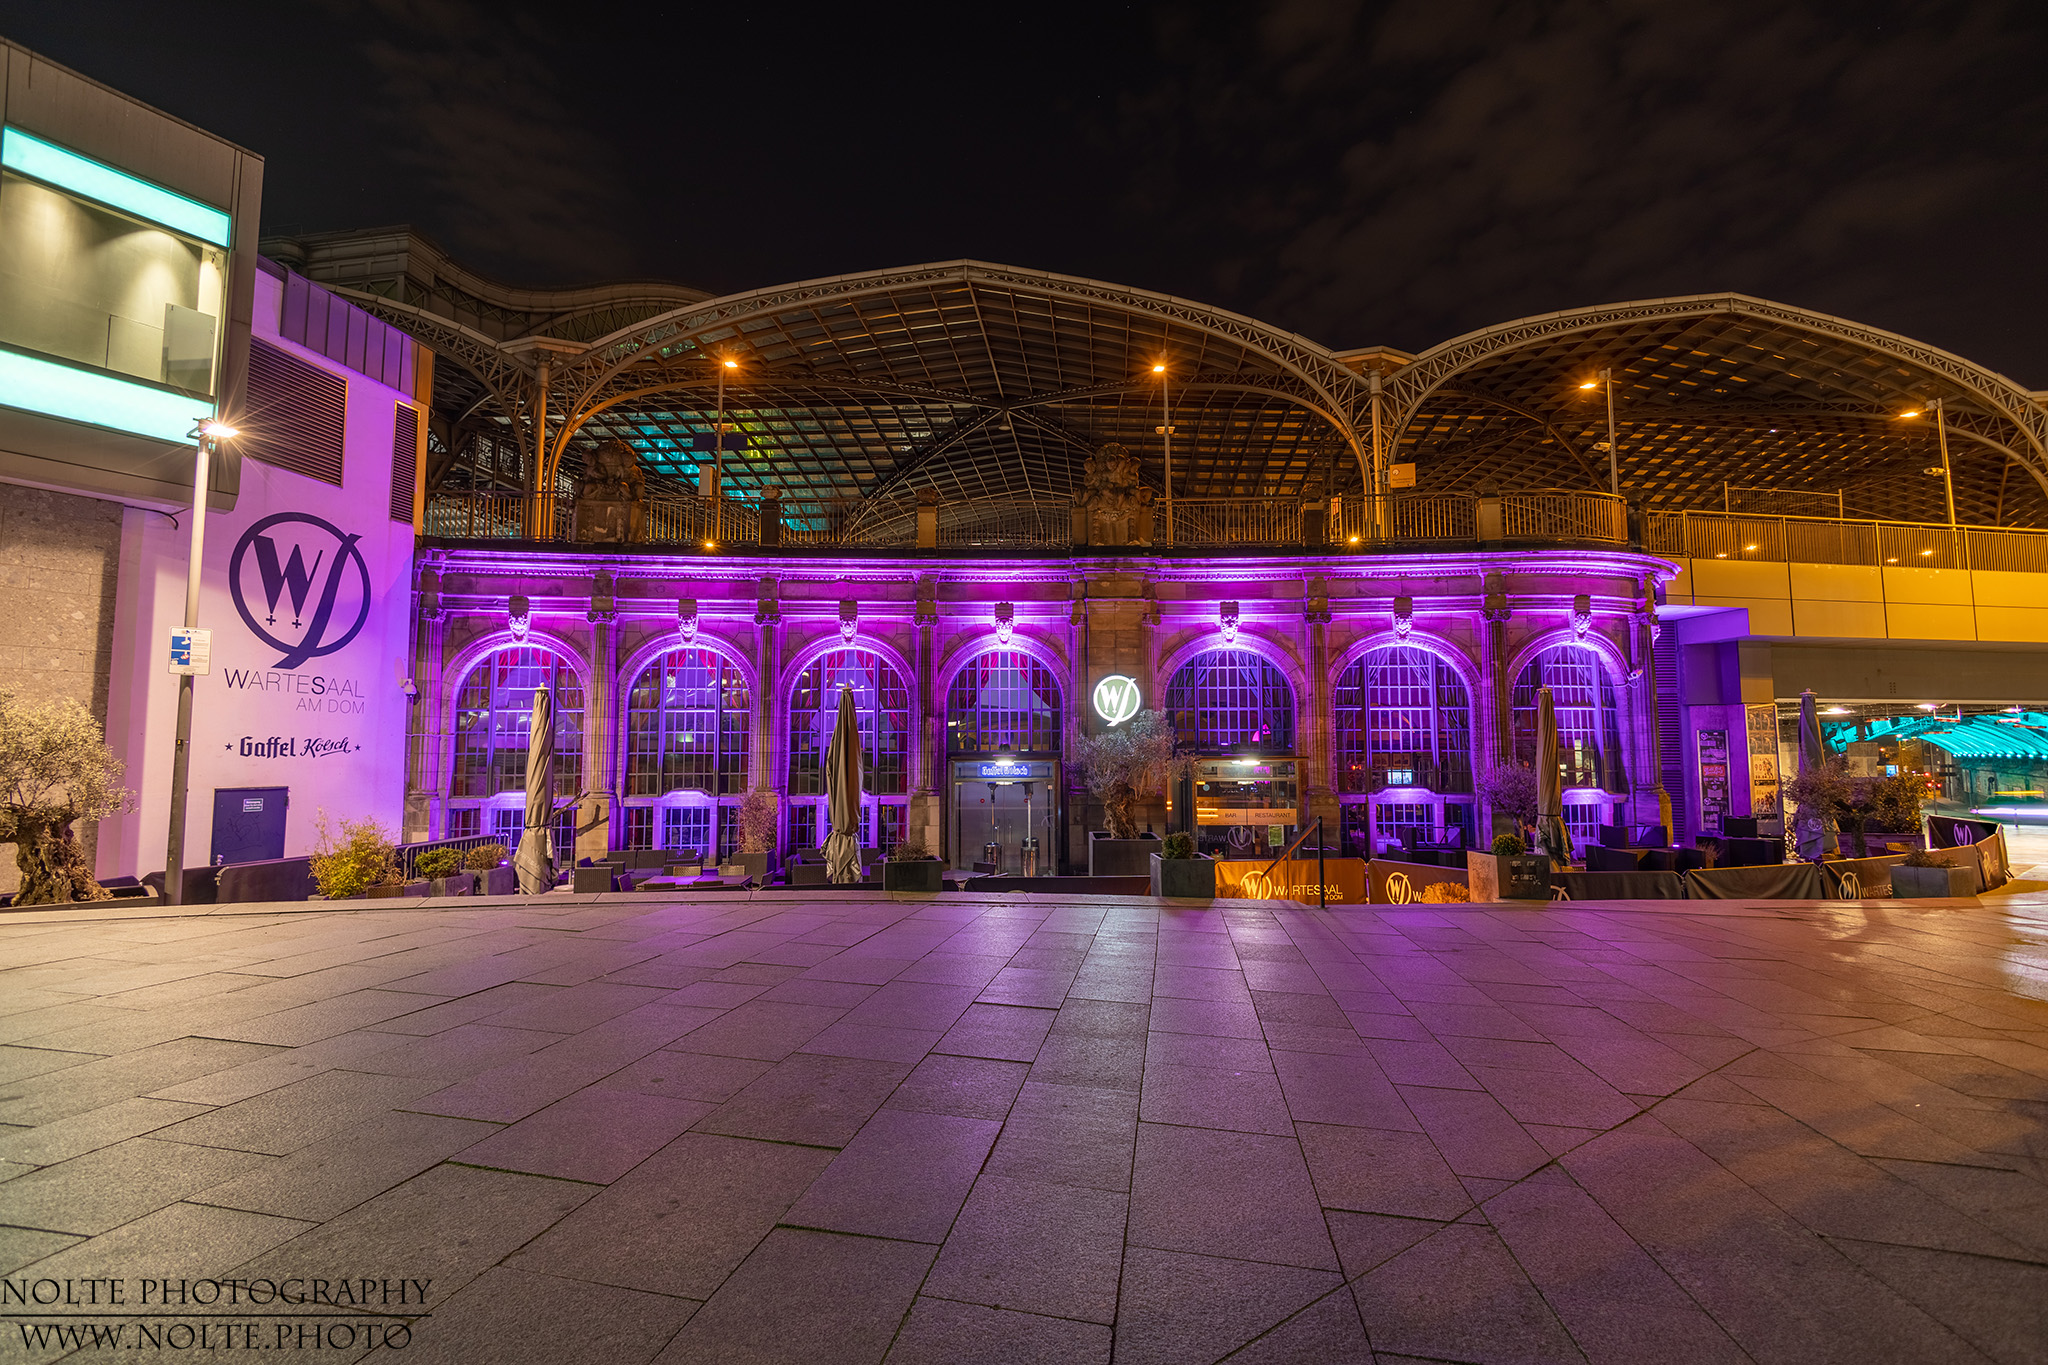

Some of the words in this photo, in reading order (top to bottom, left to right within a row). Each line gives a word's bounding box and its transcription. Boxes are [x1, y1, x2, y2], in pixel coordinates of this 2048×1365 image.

[224, 668, 365, 698] WARTESAAL
[296, 698, 322, 712] AM
[327, 699, 365, 714] DOM
[239, 736, 296, 759] Gaffel
[299, 736, 352, 758] Kölsch
[1861, 884, 1893, 898] WARTES
